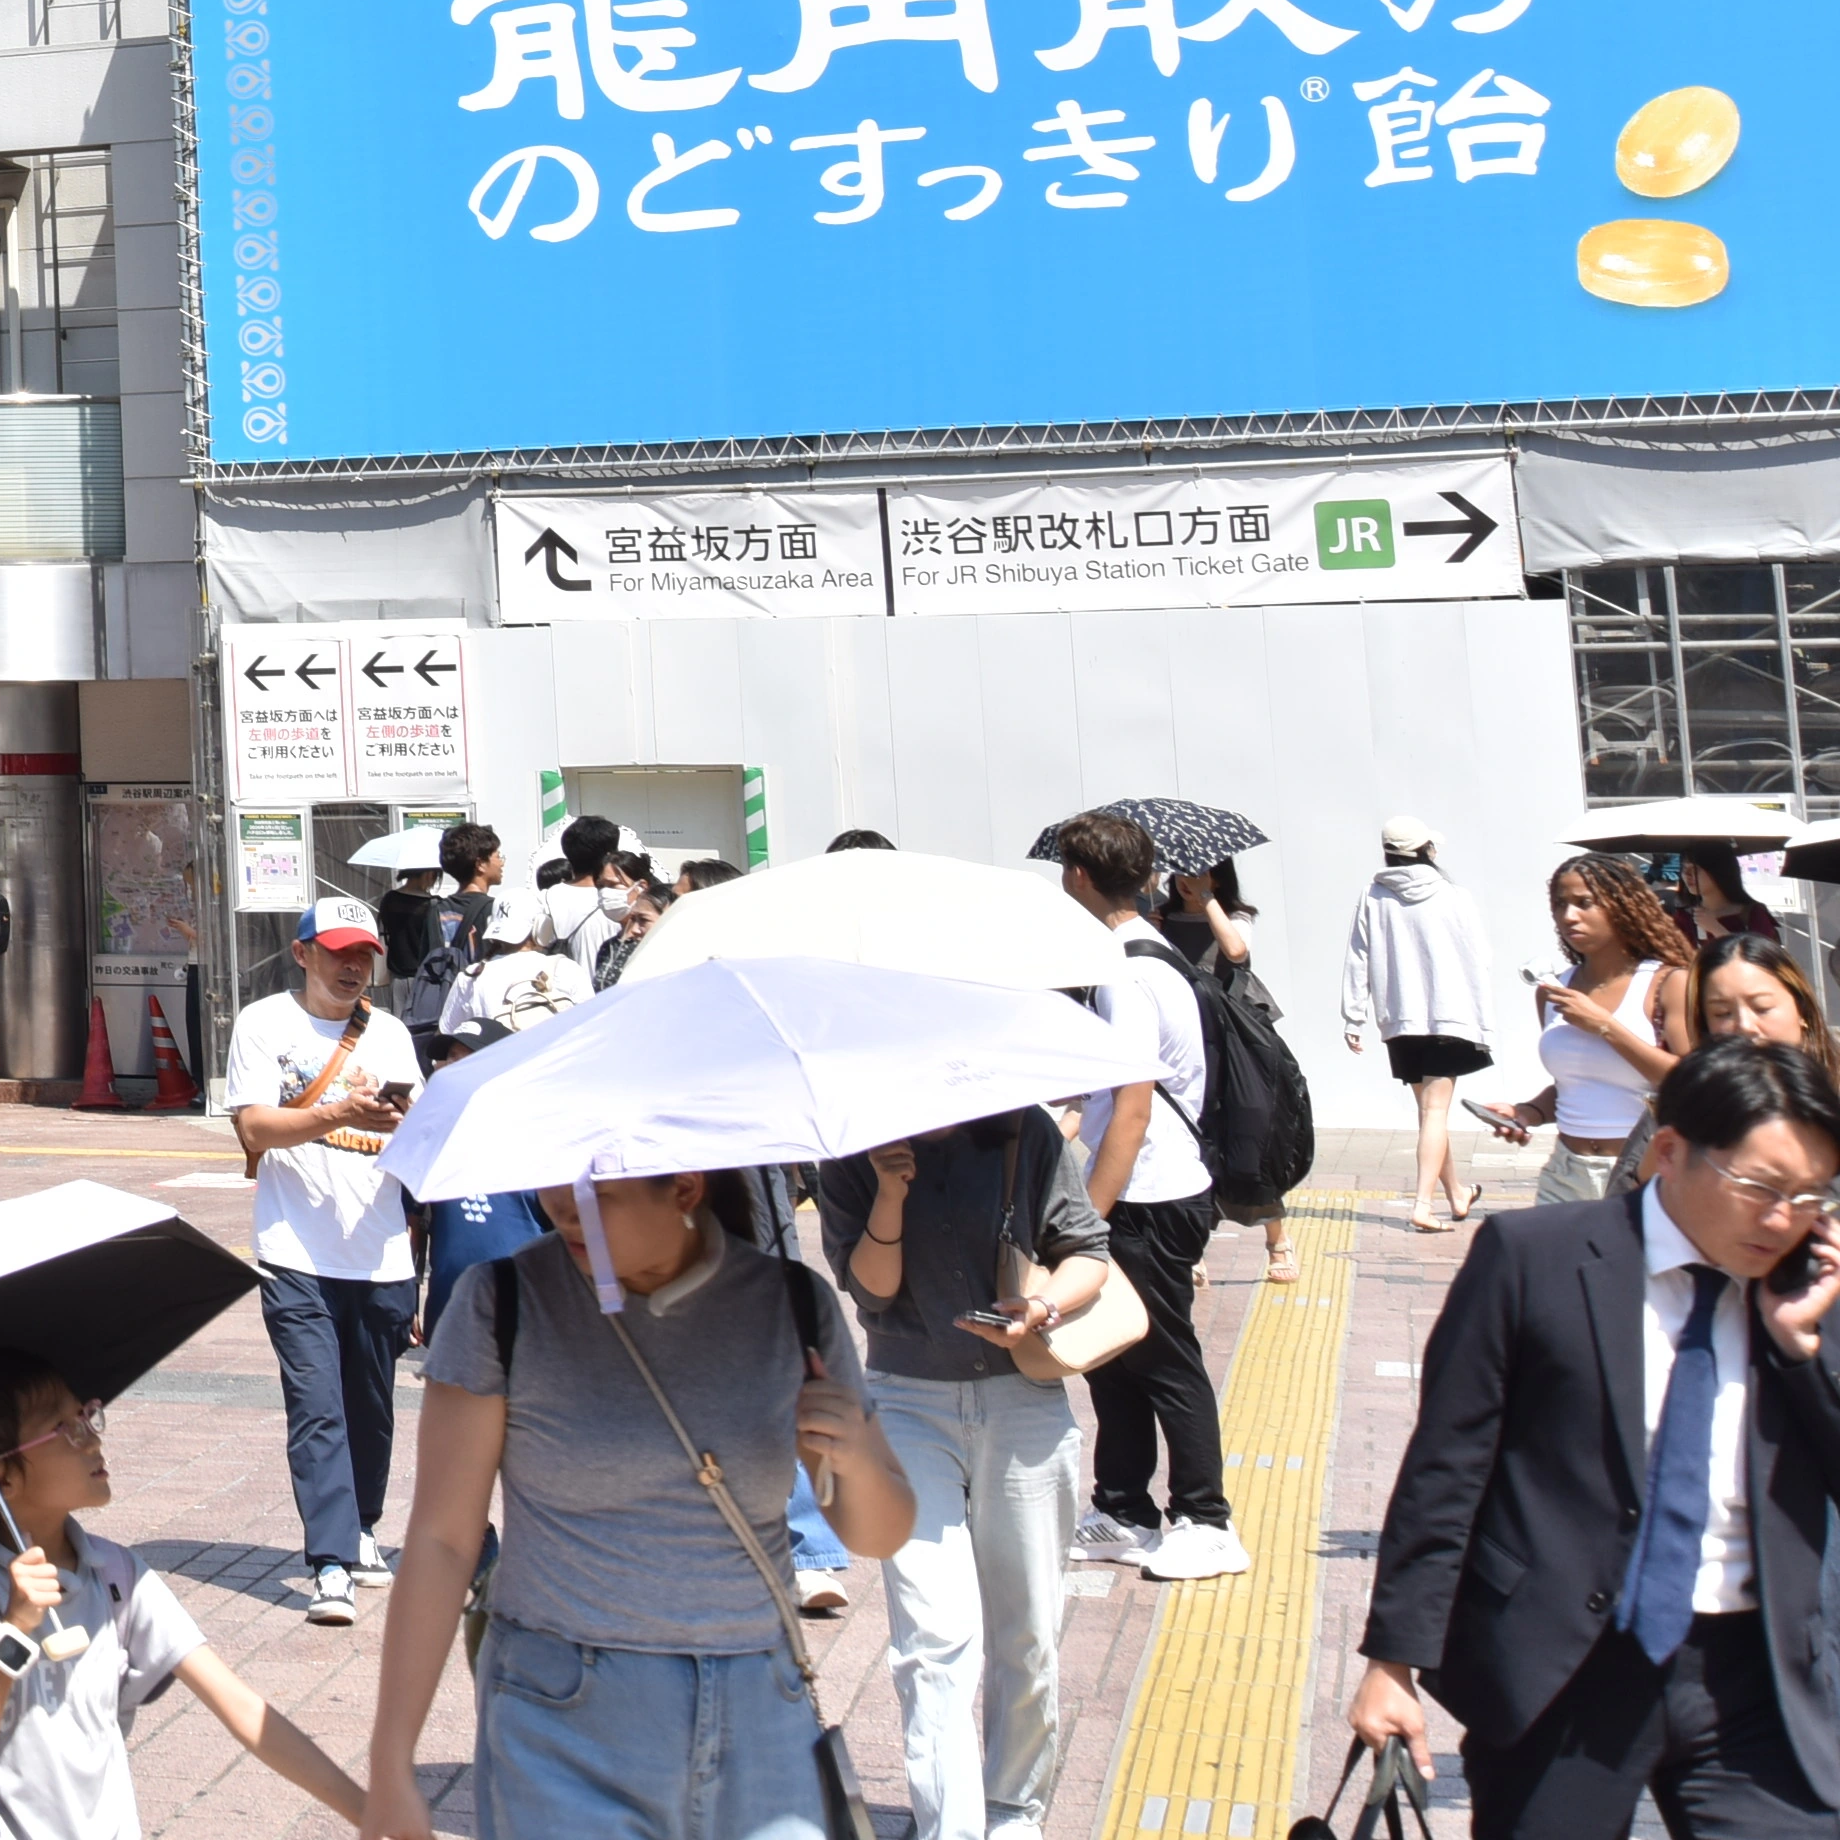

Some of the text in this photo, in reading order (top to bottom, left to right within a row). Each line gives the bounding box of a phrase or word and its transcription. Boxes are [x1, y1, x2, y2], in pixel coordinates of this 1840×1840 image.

[900, 504, 1272, 558] 渋谷駅改札口方面
[1328, 515, 1383, 555] JR
[605, 523, 818, 564] 宮益坂方面
[902, 552, 1310, 587] For JR Shibuya Station Ticket Gate
[610, 568, 874, 596] For Miyamasuzaka Area
[239, 709, 339, 724] 宮益坂方面へは
[357, 706, 460, 721] 宮益坂方面へは
[248, 727, 332, 742] 左側の歩道を
[366, 724, 453, 739] 左側の歩道を
[248, 744, 335, 760] ご利用ください
[365, 741, 456, 758] ご利用ください
[337, 903, 368, 924] DEUS
